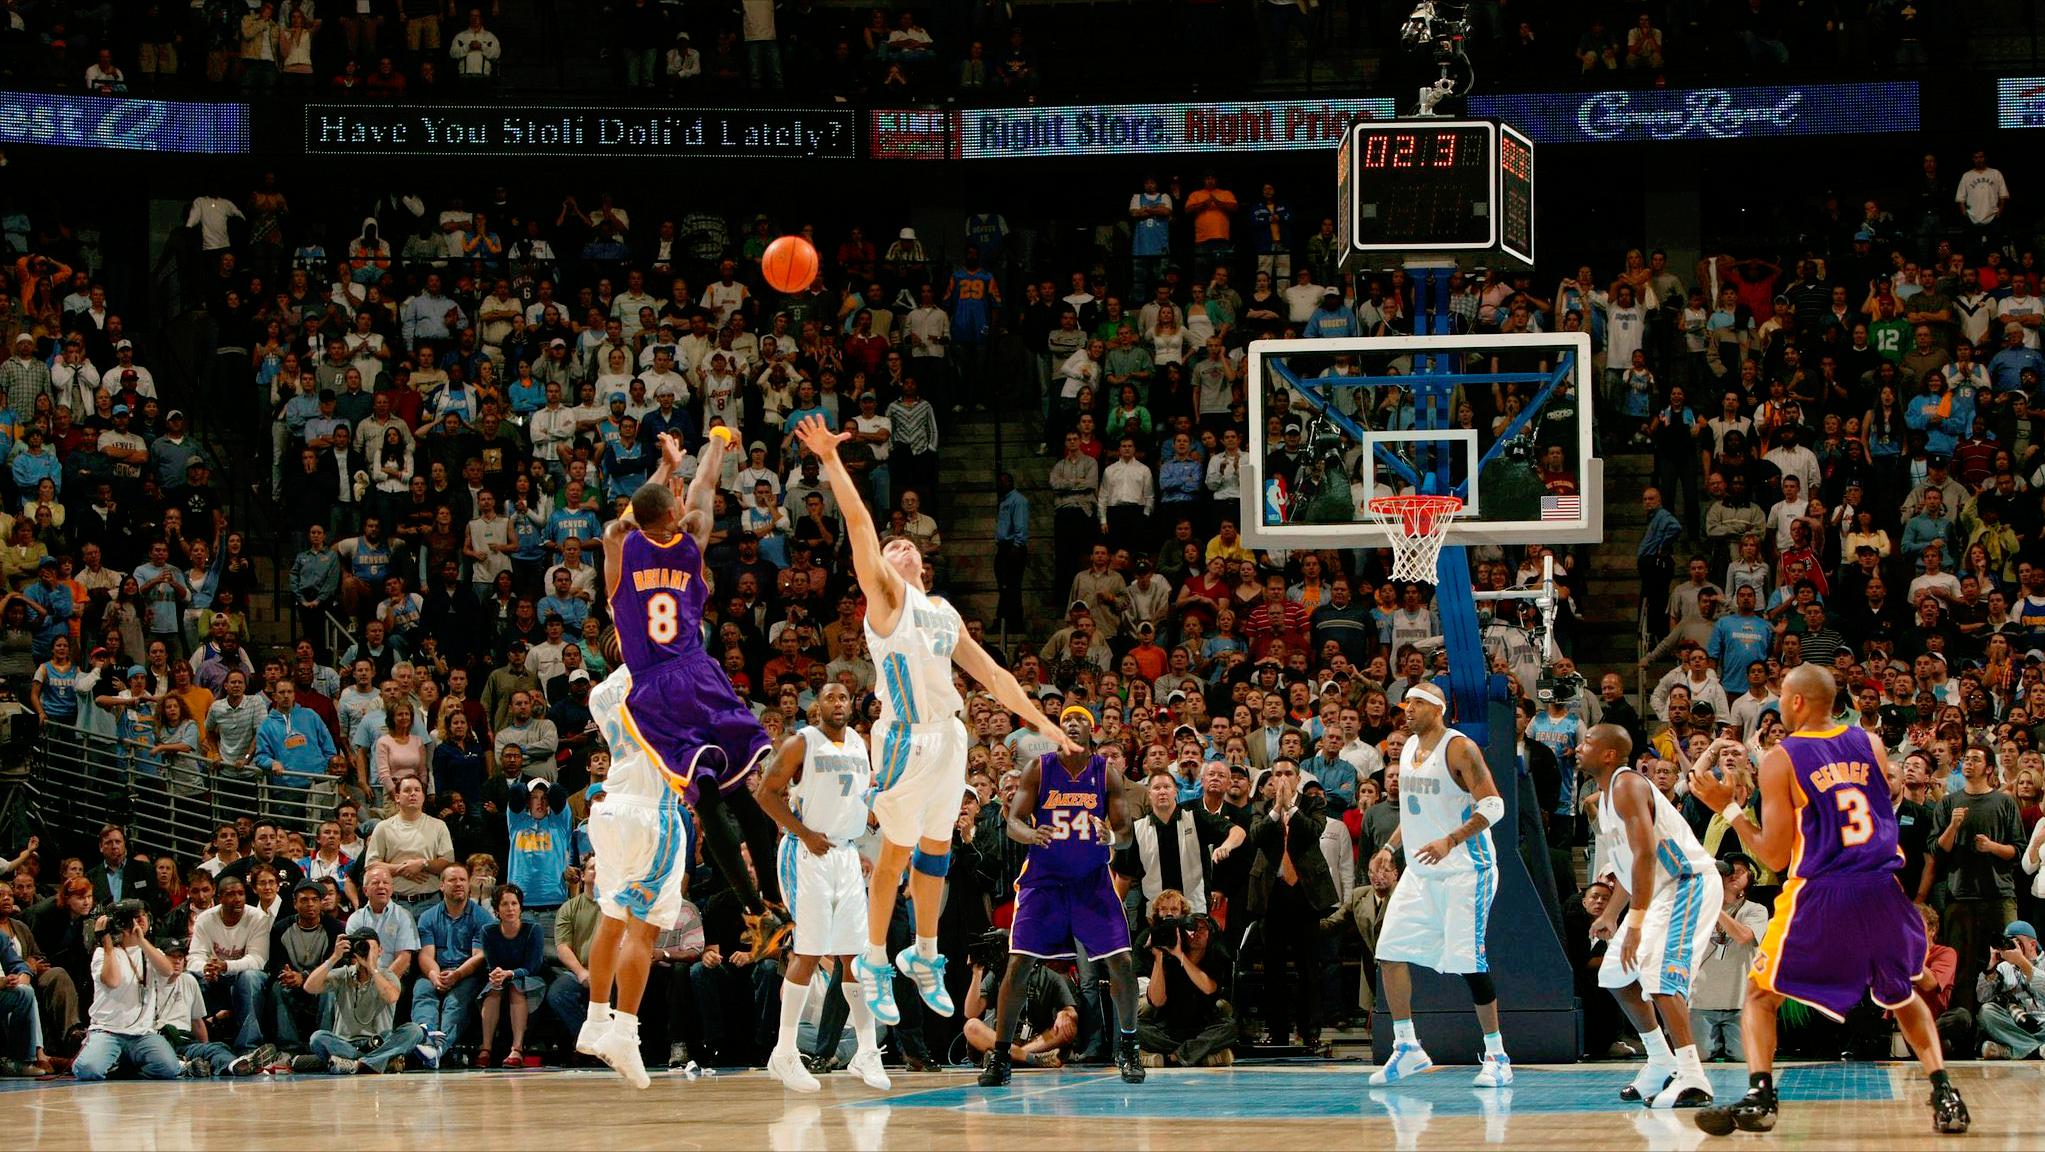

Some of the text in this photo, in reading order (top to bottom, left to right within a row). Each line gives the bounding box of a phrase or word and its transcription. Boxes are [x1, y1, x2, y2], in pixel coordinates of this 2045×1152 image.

[320, 116, 842, 156] Have You Stoli Doli'd Lately?
[979, 114, 1066, 150] Right
[1075, 111, 1171, 146] Store.
[1185, 109, 1273, 146] Right
[1876, 328, 1899, 351] 12
[717, 398, 725, 410] 8
[632, 568, 692, 592] BRYANT
[647, 592, 678, 645] 8
[1535, 731, 1570, 742] DENVER
[839, 774, 853, 797] 7
[1809, 761, 1870, 793] GEORGE
[1041, 789, 1098, 810] LAKERS
[1407, 794, 1421, 816] 6
[1052, 809, 1091, 841] 54
[1835, 787, 1875, 848] 3
